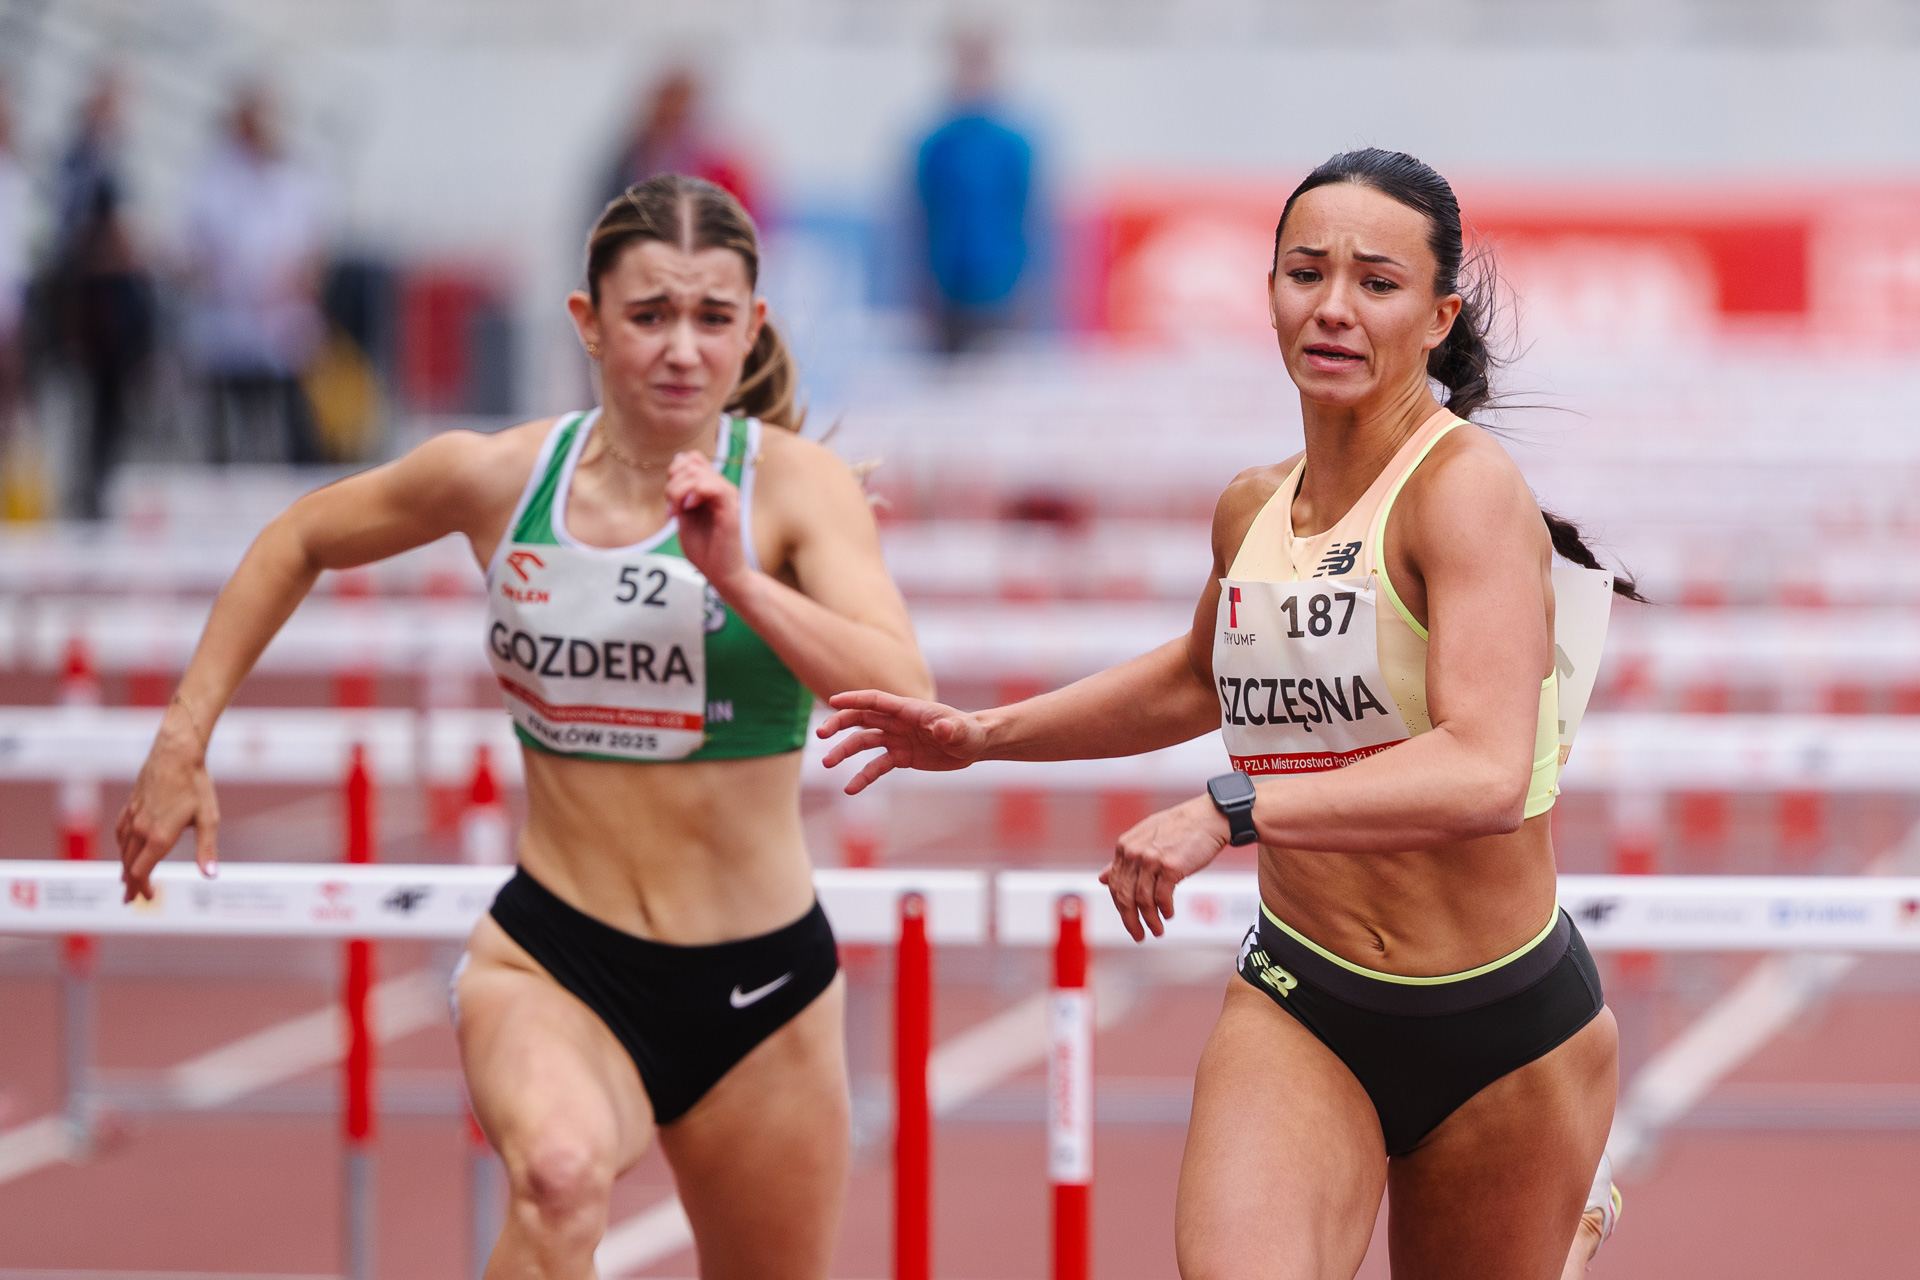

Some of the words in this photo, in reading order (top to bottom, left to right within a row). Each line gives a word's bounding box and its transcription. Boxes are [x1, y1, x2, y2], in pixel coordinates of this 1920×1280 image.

[616, 566, 669, 607] 52
[1280, 591, 1356, 638] 187
[490, 621, 694, 685] GOZDERA
[1223, 631, 1256, 646] TRYUMF
[1219, 675, 1389, 733] SZCZĘSNA
[607, 732, 659, 750] 2025
[1244, 759, 1270, 772] PZLA
[1271, 757, 1333, 771] Mistrzostwa
[1333, 751, 1367, 768] Polski
